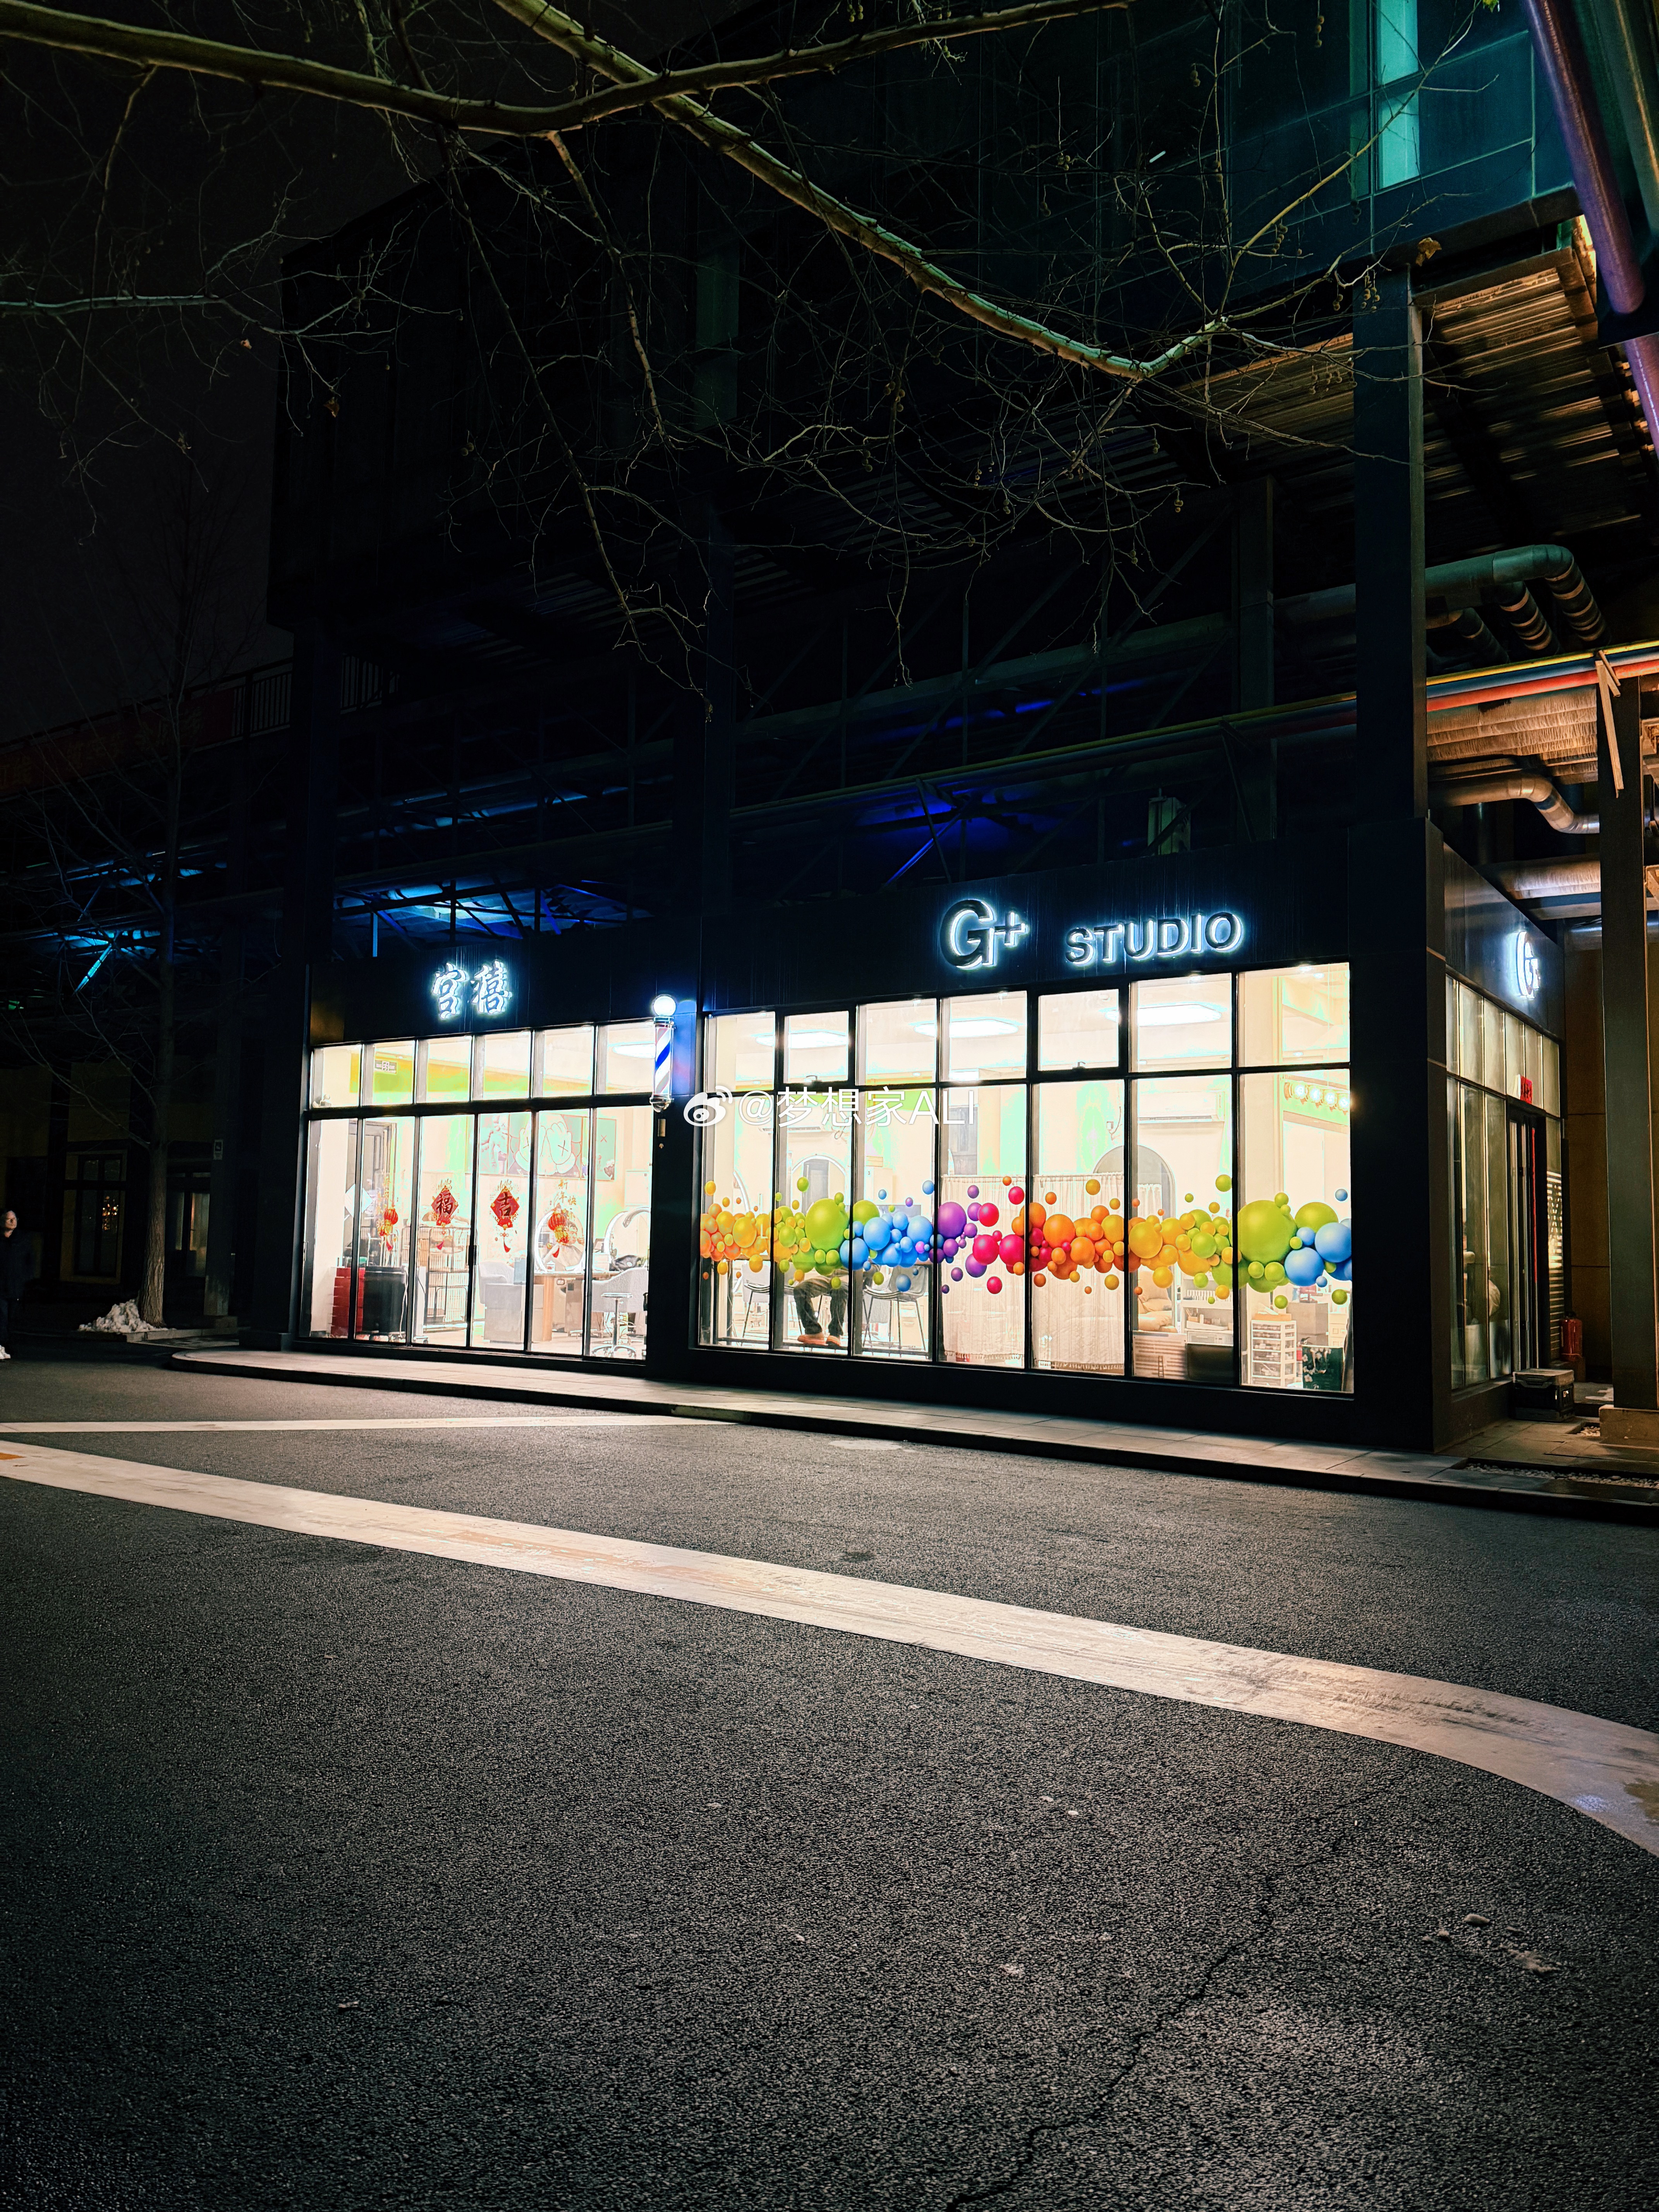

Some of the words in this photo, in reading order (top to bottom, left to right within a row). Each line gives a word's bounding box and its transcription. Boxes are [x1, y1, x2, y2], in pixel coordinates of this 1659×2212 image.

[940, 898, 1028, 970] G+
[1065, 912, 1242, 965] STUDIO
[436, 1193, 453, 1215] 福
[496, 1192, 512, 1217] 吉
